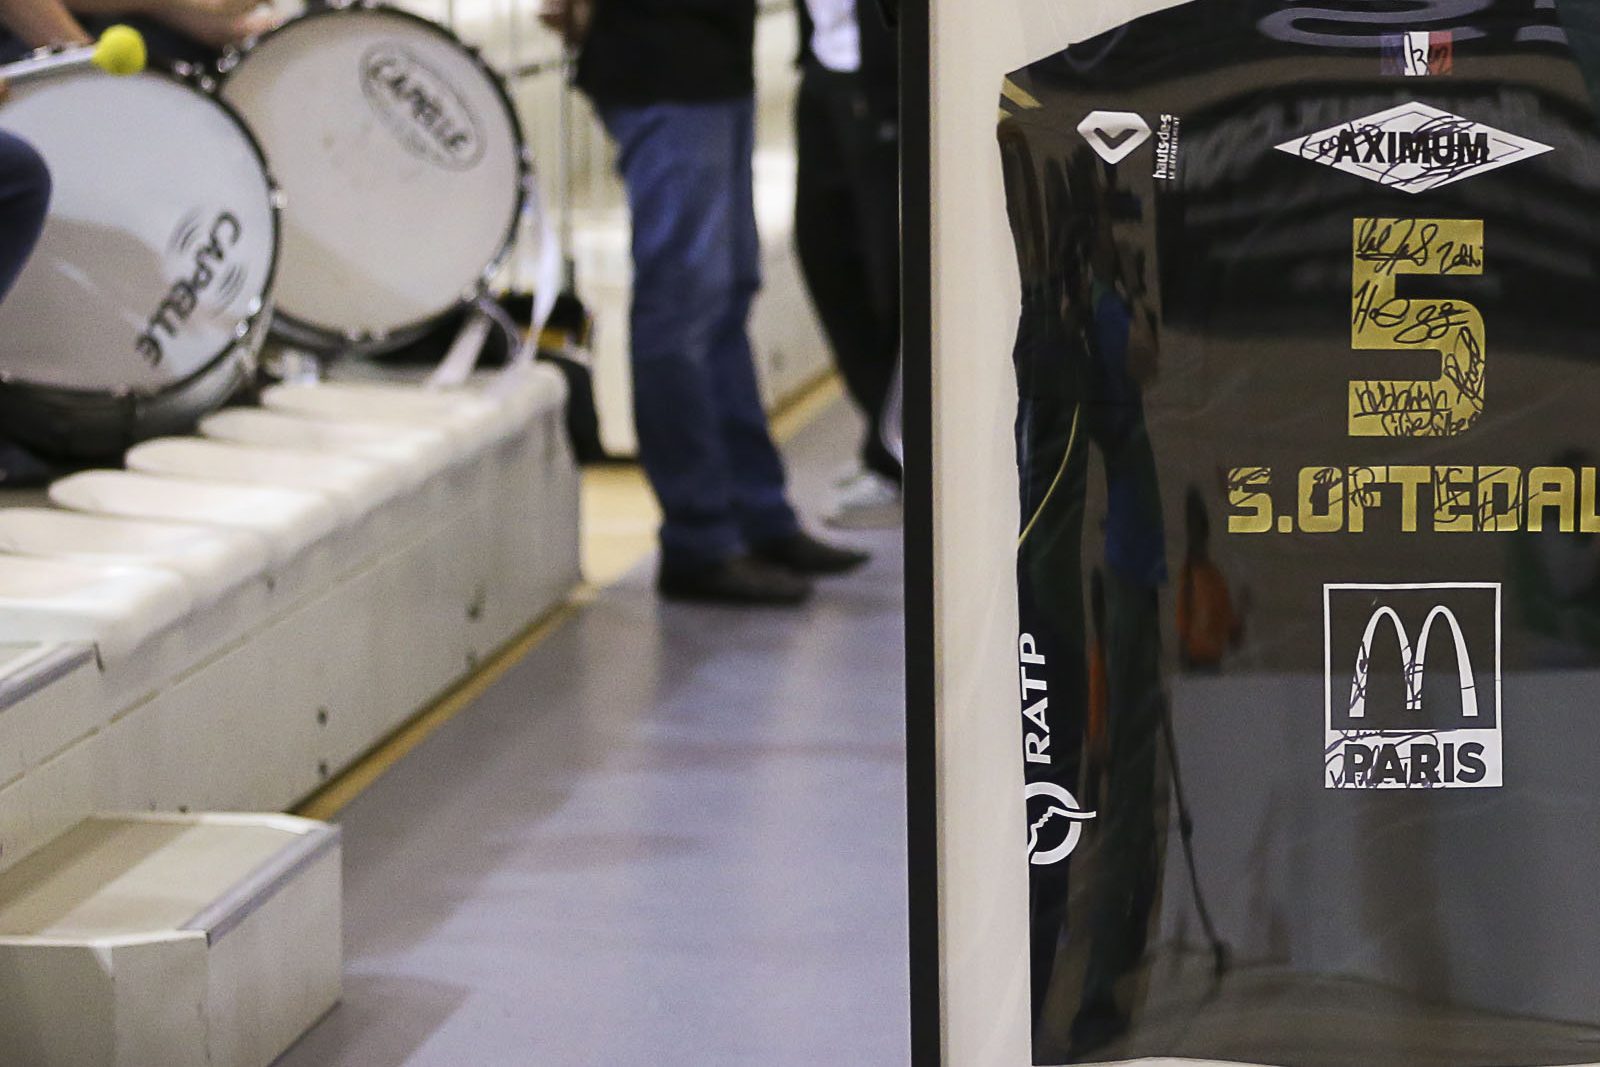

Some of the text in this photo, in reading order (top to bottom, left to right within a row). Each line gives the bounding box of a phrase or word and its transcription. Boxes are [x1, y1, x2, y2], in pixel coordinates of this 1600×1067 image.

[1333, 131, 1489, 165] AXIMUM
[135, 211, 242, 368] CAPELLE
[1348, 217, 1487, 437] 5
[1018, 632, 1052, 765] RATP
[1343, 741, 1487, 785] PARIS
